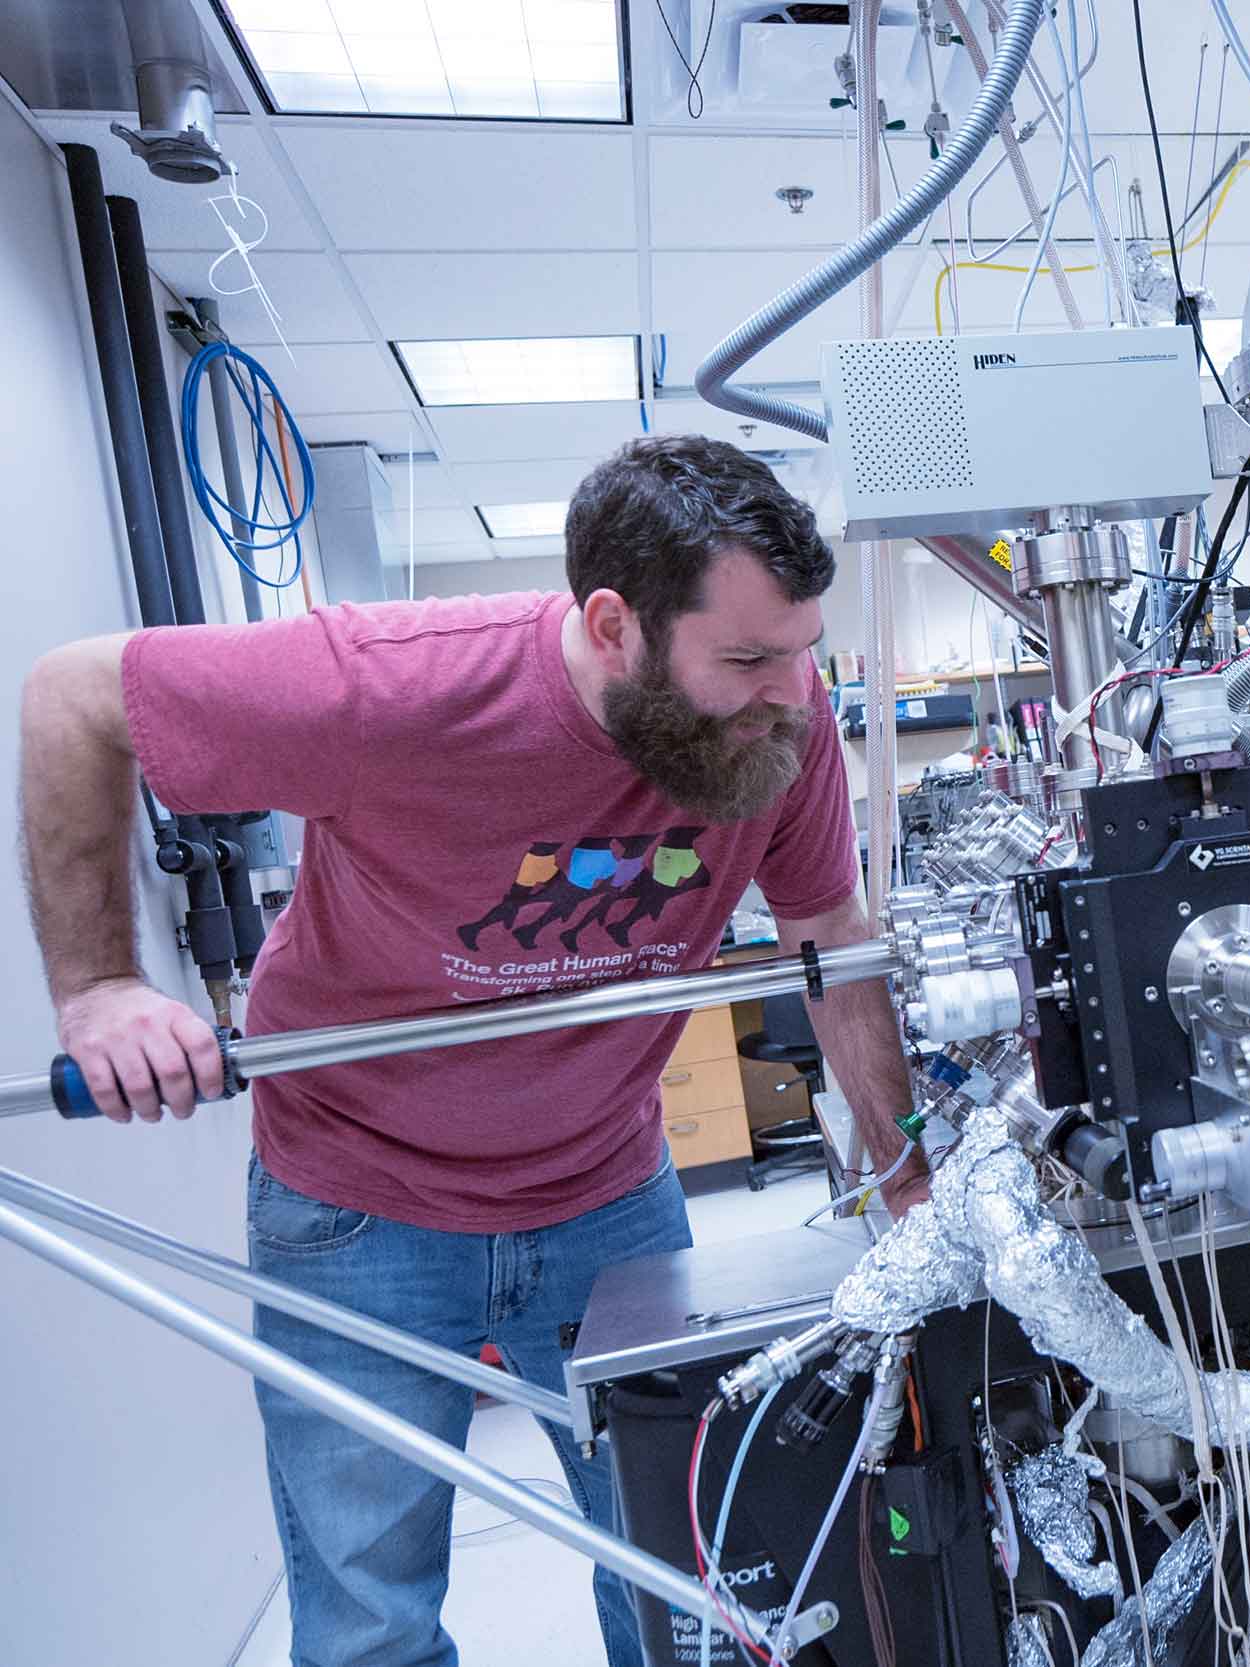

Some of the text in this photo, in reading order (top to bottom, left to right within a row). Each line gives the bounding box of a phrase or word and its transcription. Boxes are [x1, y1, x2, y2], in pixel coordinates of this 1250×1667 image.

[973, 352, 1016, 370] HIDEN
[498, 957, 558, 975] Great
[563, 952, 633, 972] Human
[443, 967, 553, 986] Transforming
[557, 973, 588, 983] one
[590, 970, 622, 981] step
[670, 1614, 699, 1632] High
